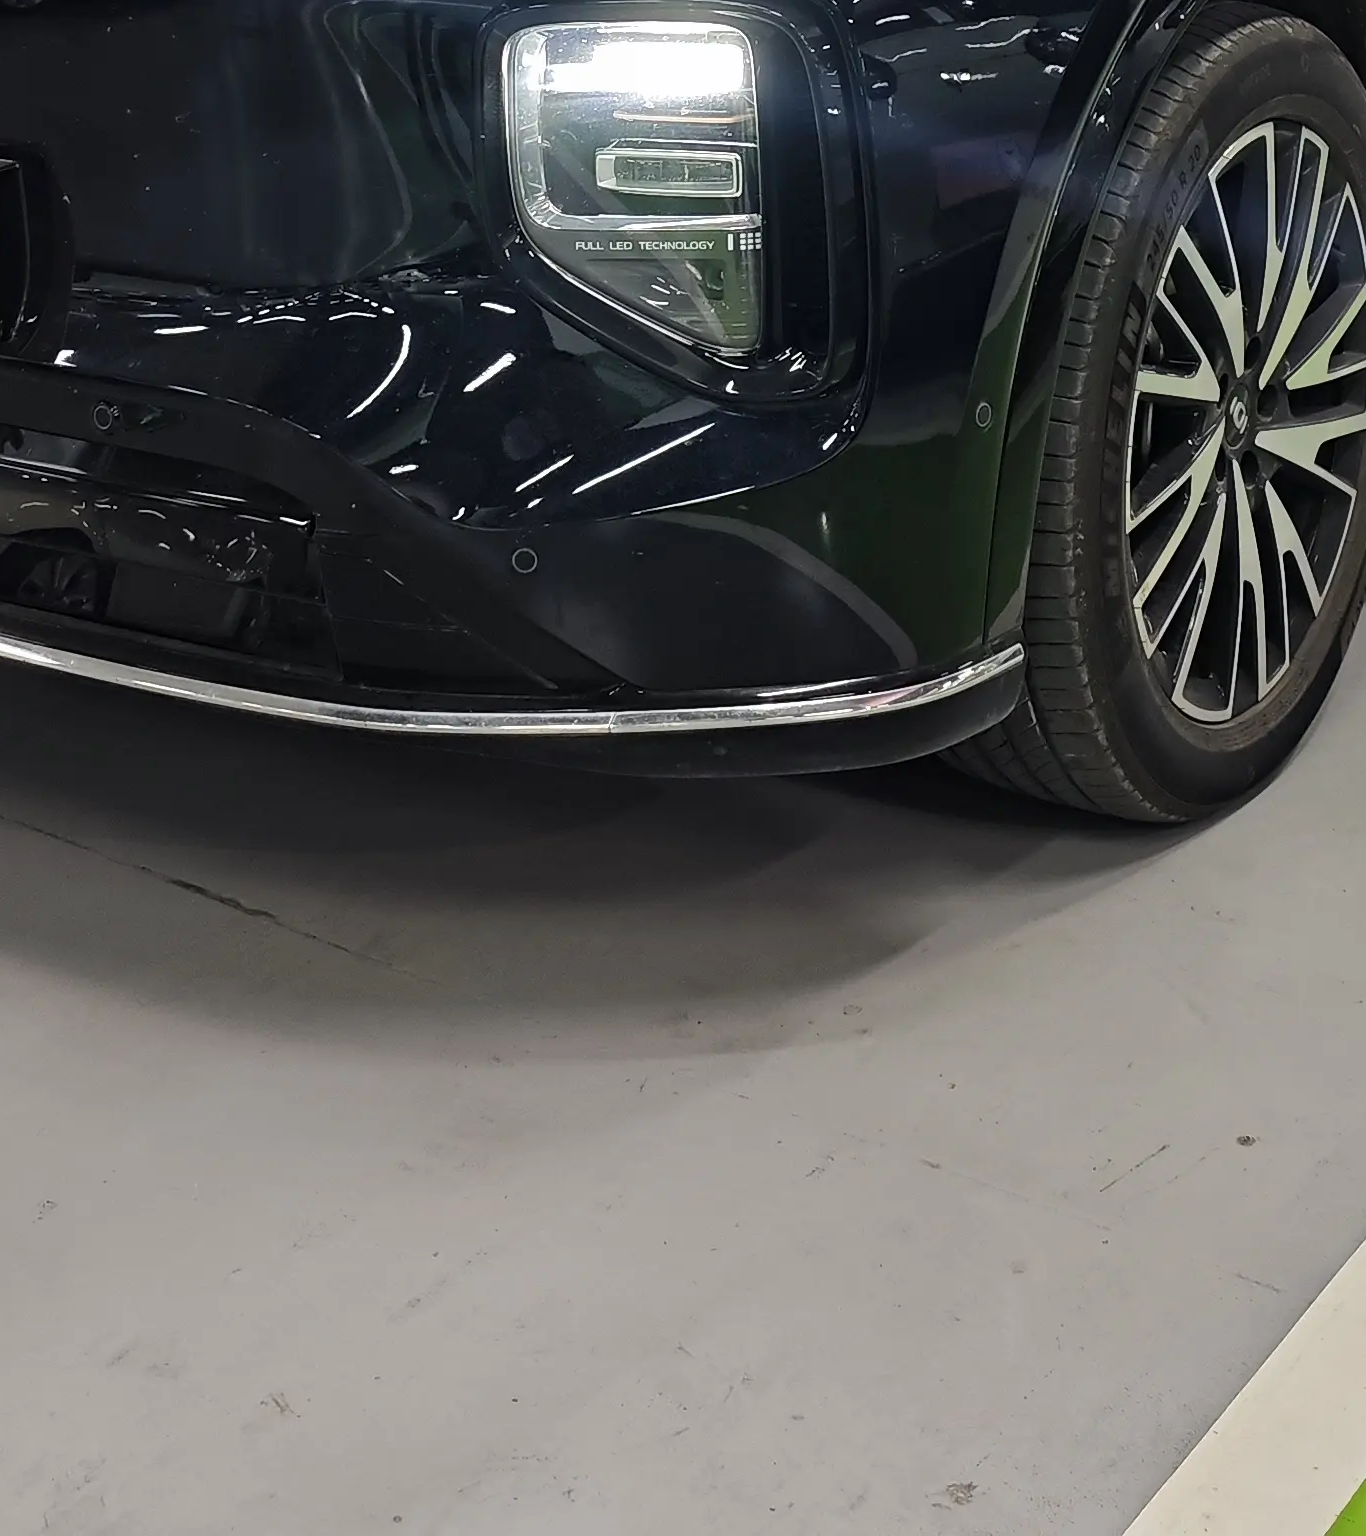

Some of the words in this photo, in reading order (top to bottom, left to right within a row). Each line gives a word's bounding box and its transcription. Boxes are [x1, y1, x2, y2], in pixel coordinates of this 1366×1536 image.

[575, 240, 604, 251] FULL
[610, 240, 633, 251] LED
[638, 240, 716, 252] TECHNOLOGY
